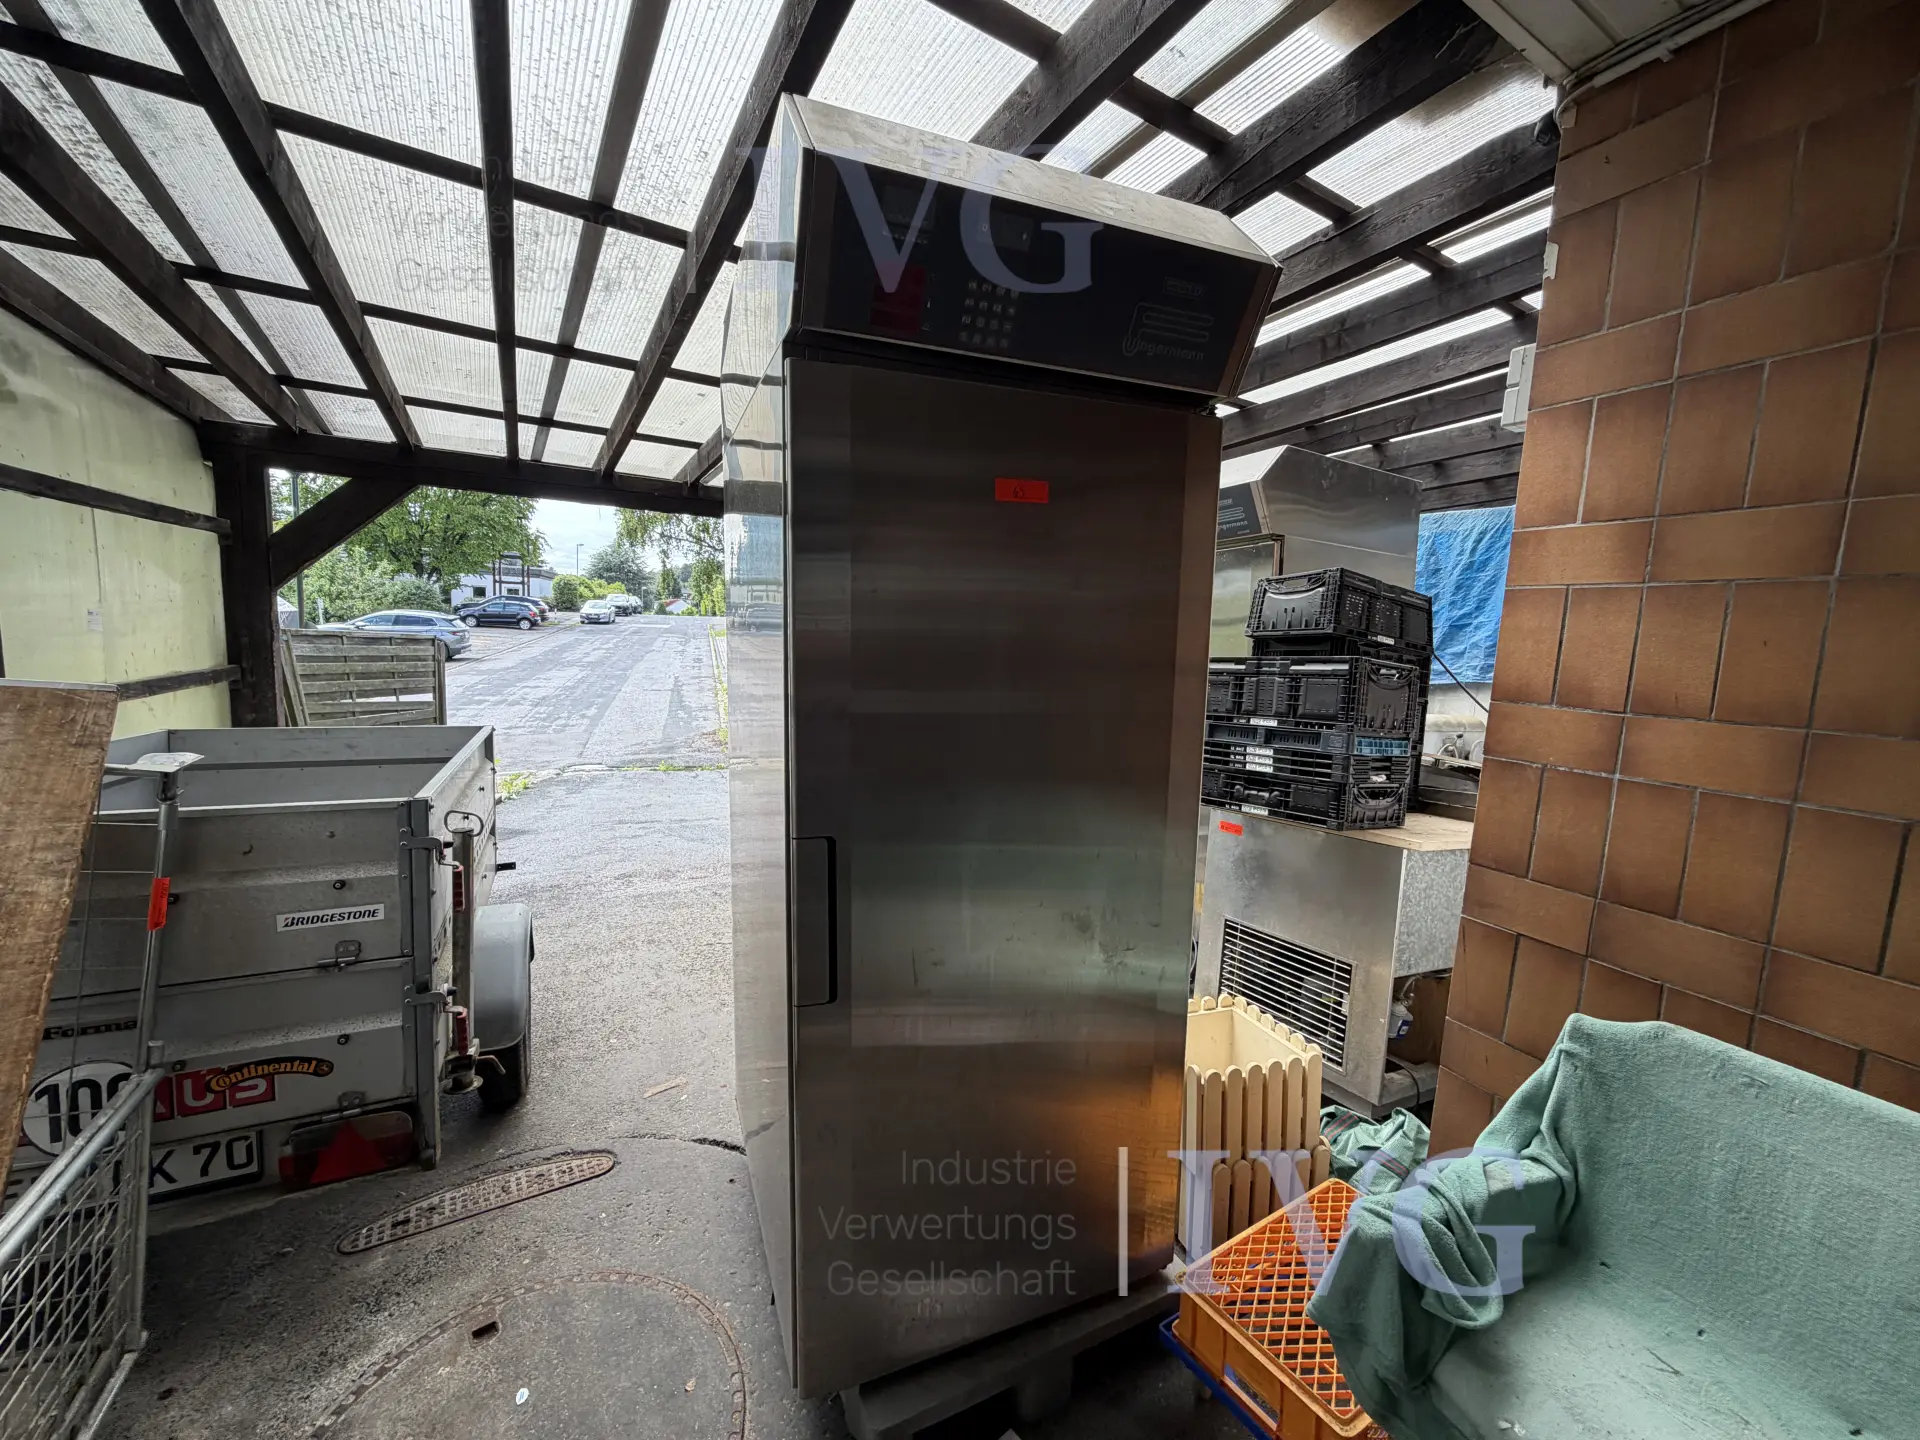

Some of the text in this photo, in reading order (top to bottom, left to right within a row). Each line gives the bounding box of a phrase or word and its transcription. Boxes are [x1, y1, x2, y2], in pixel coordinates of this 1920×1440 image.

[283, 908, 380, 928] BRIDGESTONE
[209, 1058, 317, 1093] Continental
[192, 1136, 254, 1178] 70
